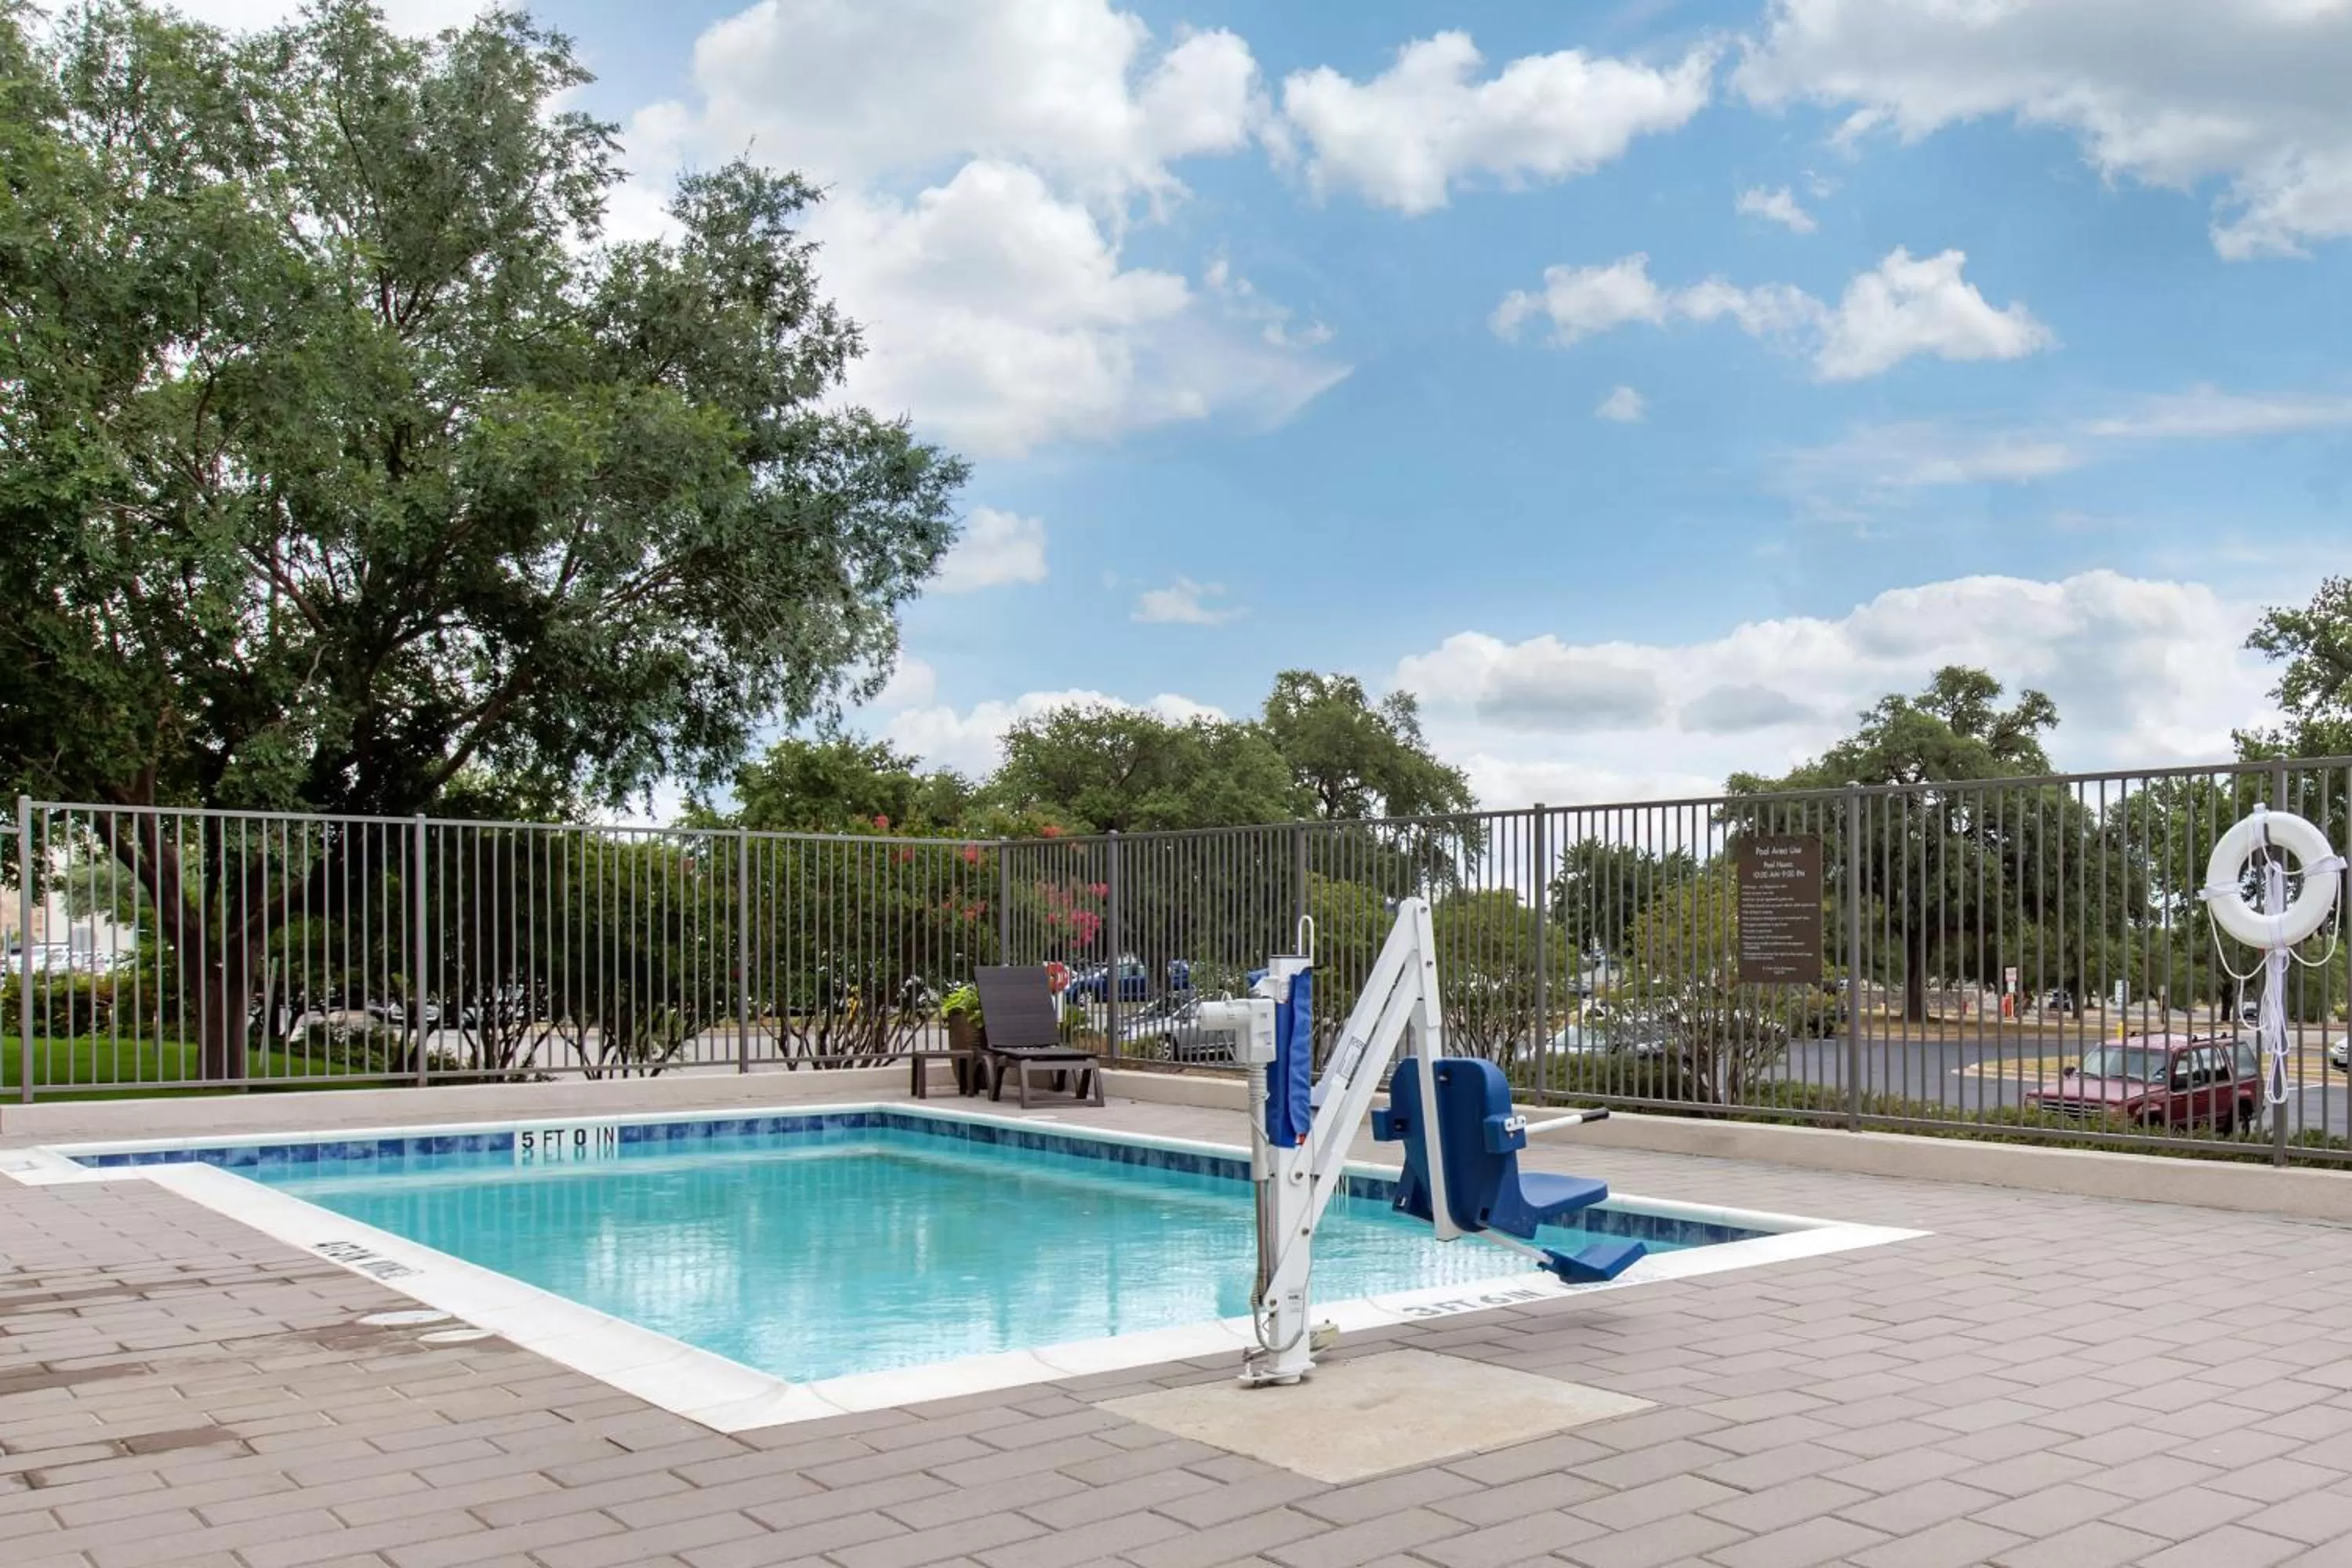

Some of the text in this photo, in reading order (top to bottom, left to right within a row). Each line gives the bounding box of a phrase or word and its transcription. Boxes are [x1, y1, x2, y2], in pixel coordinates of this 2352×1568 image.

[1755, 847, 1769, 855] Pool
[1772, 846, 1788, 855] Area
[521, 1126, 615, 1149] 5 FT 0 IN
[1402, 1289, 1548, 1316] 3 FT 6 IN
